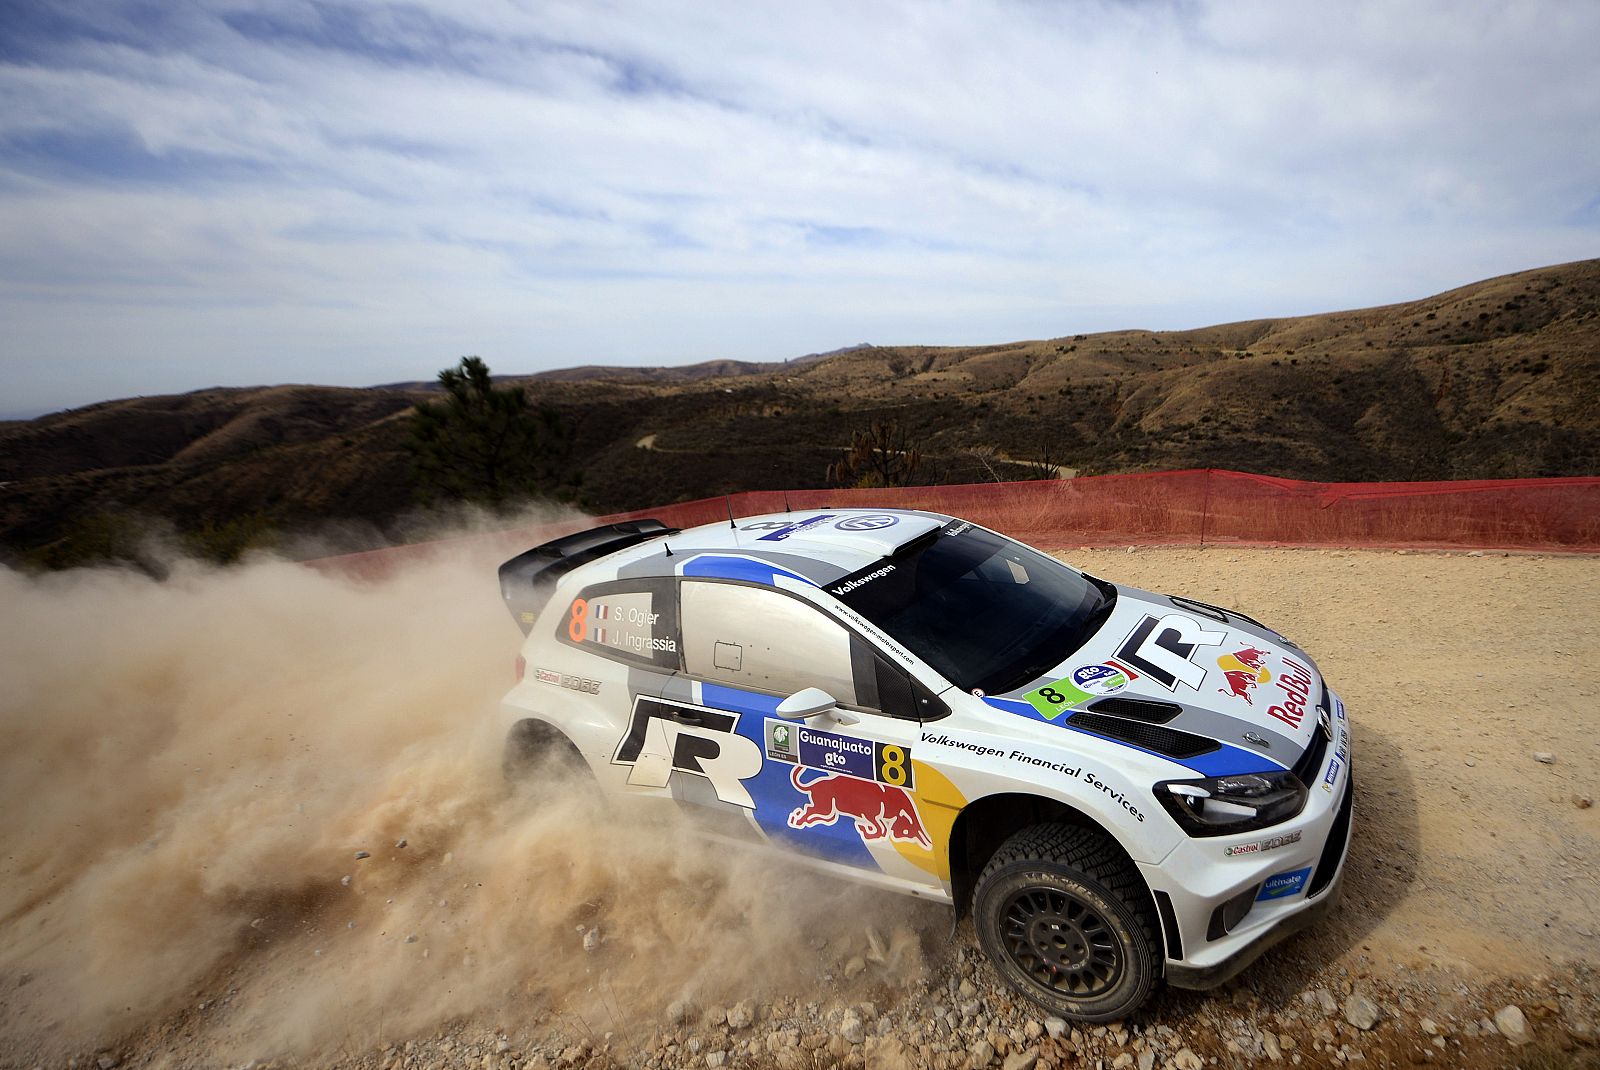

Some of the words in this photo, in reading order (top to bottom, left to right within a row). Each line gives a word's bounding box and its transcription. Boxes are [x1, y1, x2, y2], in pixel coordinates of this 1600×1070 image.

[832, 563, 896, 596] Volkswagen
[569, 598, 588, 642] 8
[614, 607, 624, 622] S.
[628, 608, 660, 627] Ogier
[612, 632, 622, 646] J.
[625, 632, 677, 653] Ingrassia
[834, 604, 915, 666] www.volkswagen-motorsport.com
[1111, 613, 1228, 693] R
[1077, 666, 1100, 680] gto
[1038, 687, 1066, 704] 8
[610, 693, 763, 810] R
[799, 730, 872, 756] Guanajuato
[824, 752, 846, 767] gto
[881, 744, 907, 786] 8
[920, 732, 1005, 758] Volkswagen
[1008, 750, 1082, 778] Financial
[1083, 773, 1146, 823] Services
[1233, 843, 1258, 855] Castrol
[1265, 875, 1301, 889] ultimate
